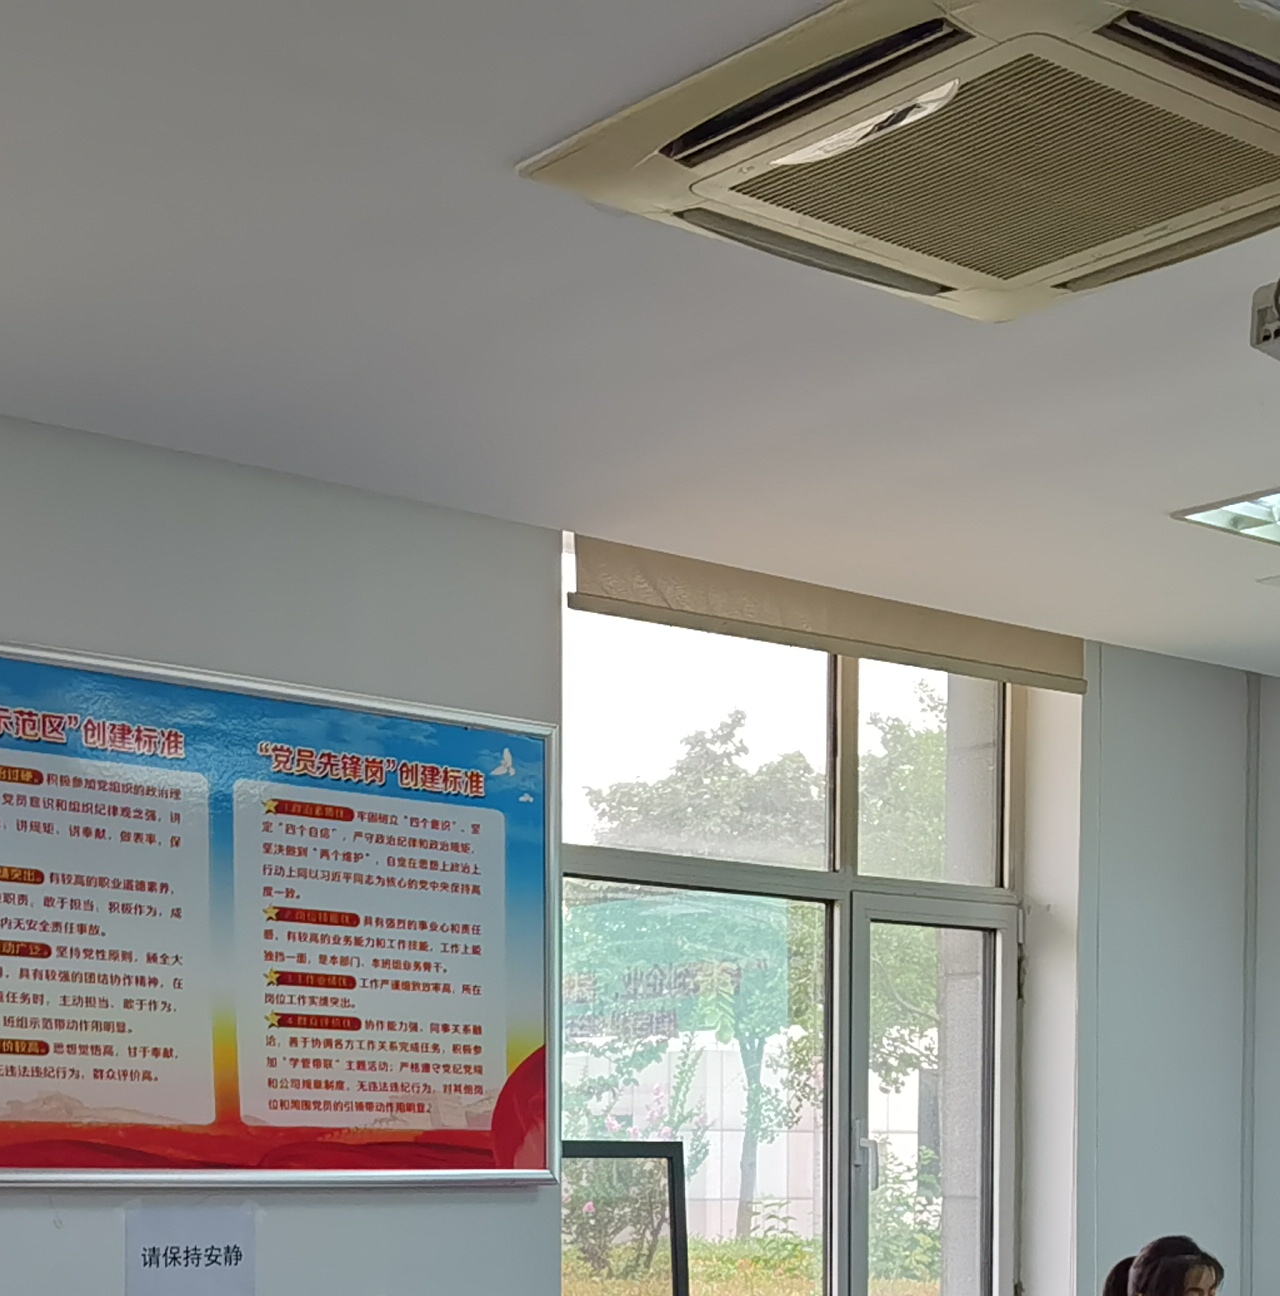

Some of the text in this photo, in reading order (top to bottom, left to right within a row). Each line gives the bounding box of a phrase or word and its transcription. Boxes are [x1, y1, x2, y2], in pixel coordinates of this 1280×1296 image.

[258, 741, 485, 797] “党员先锋岗”创建标准
[141, 1243, 243, 1269] 请保持安静
